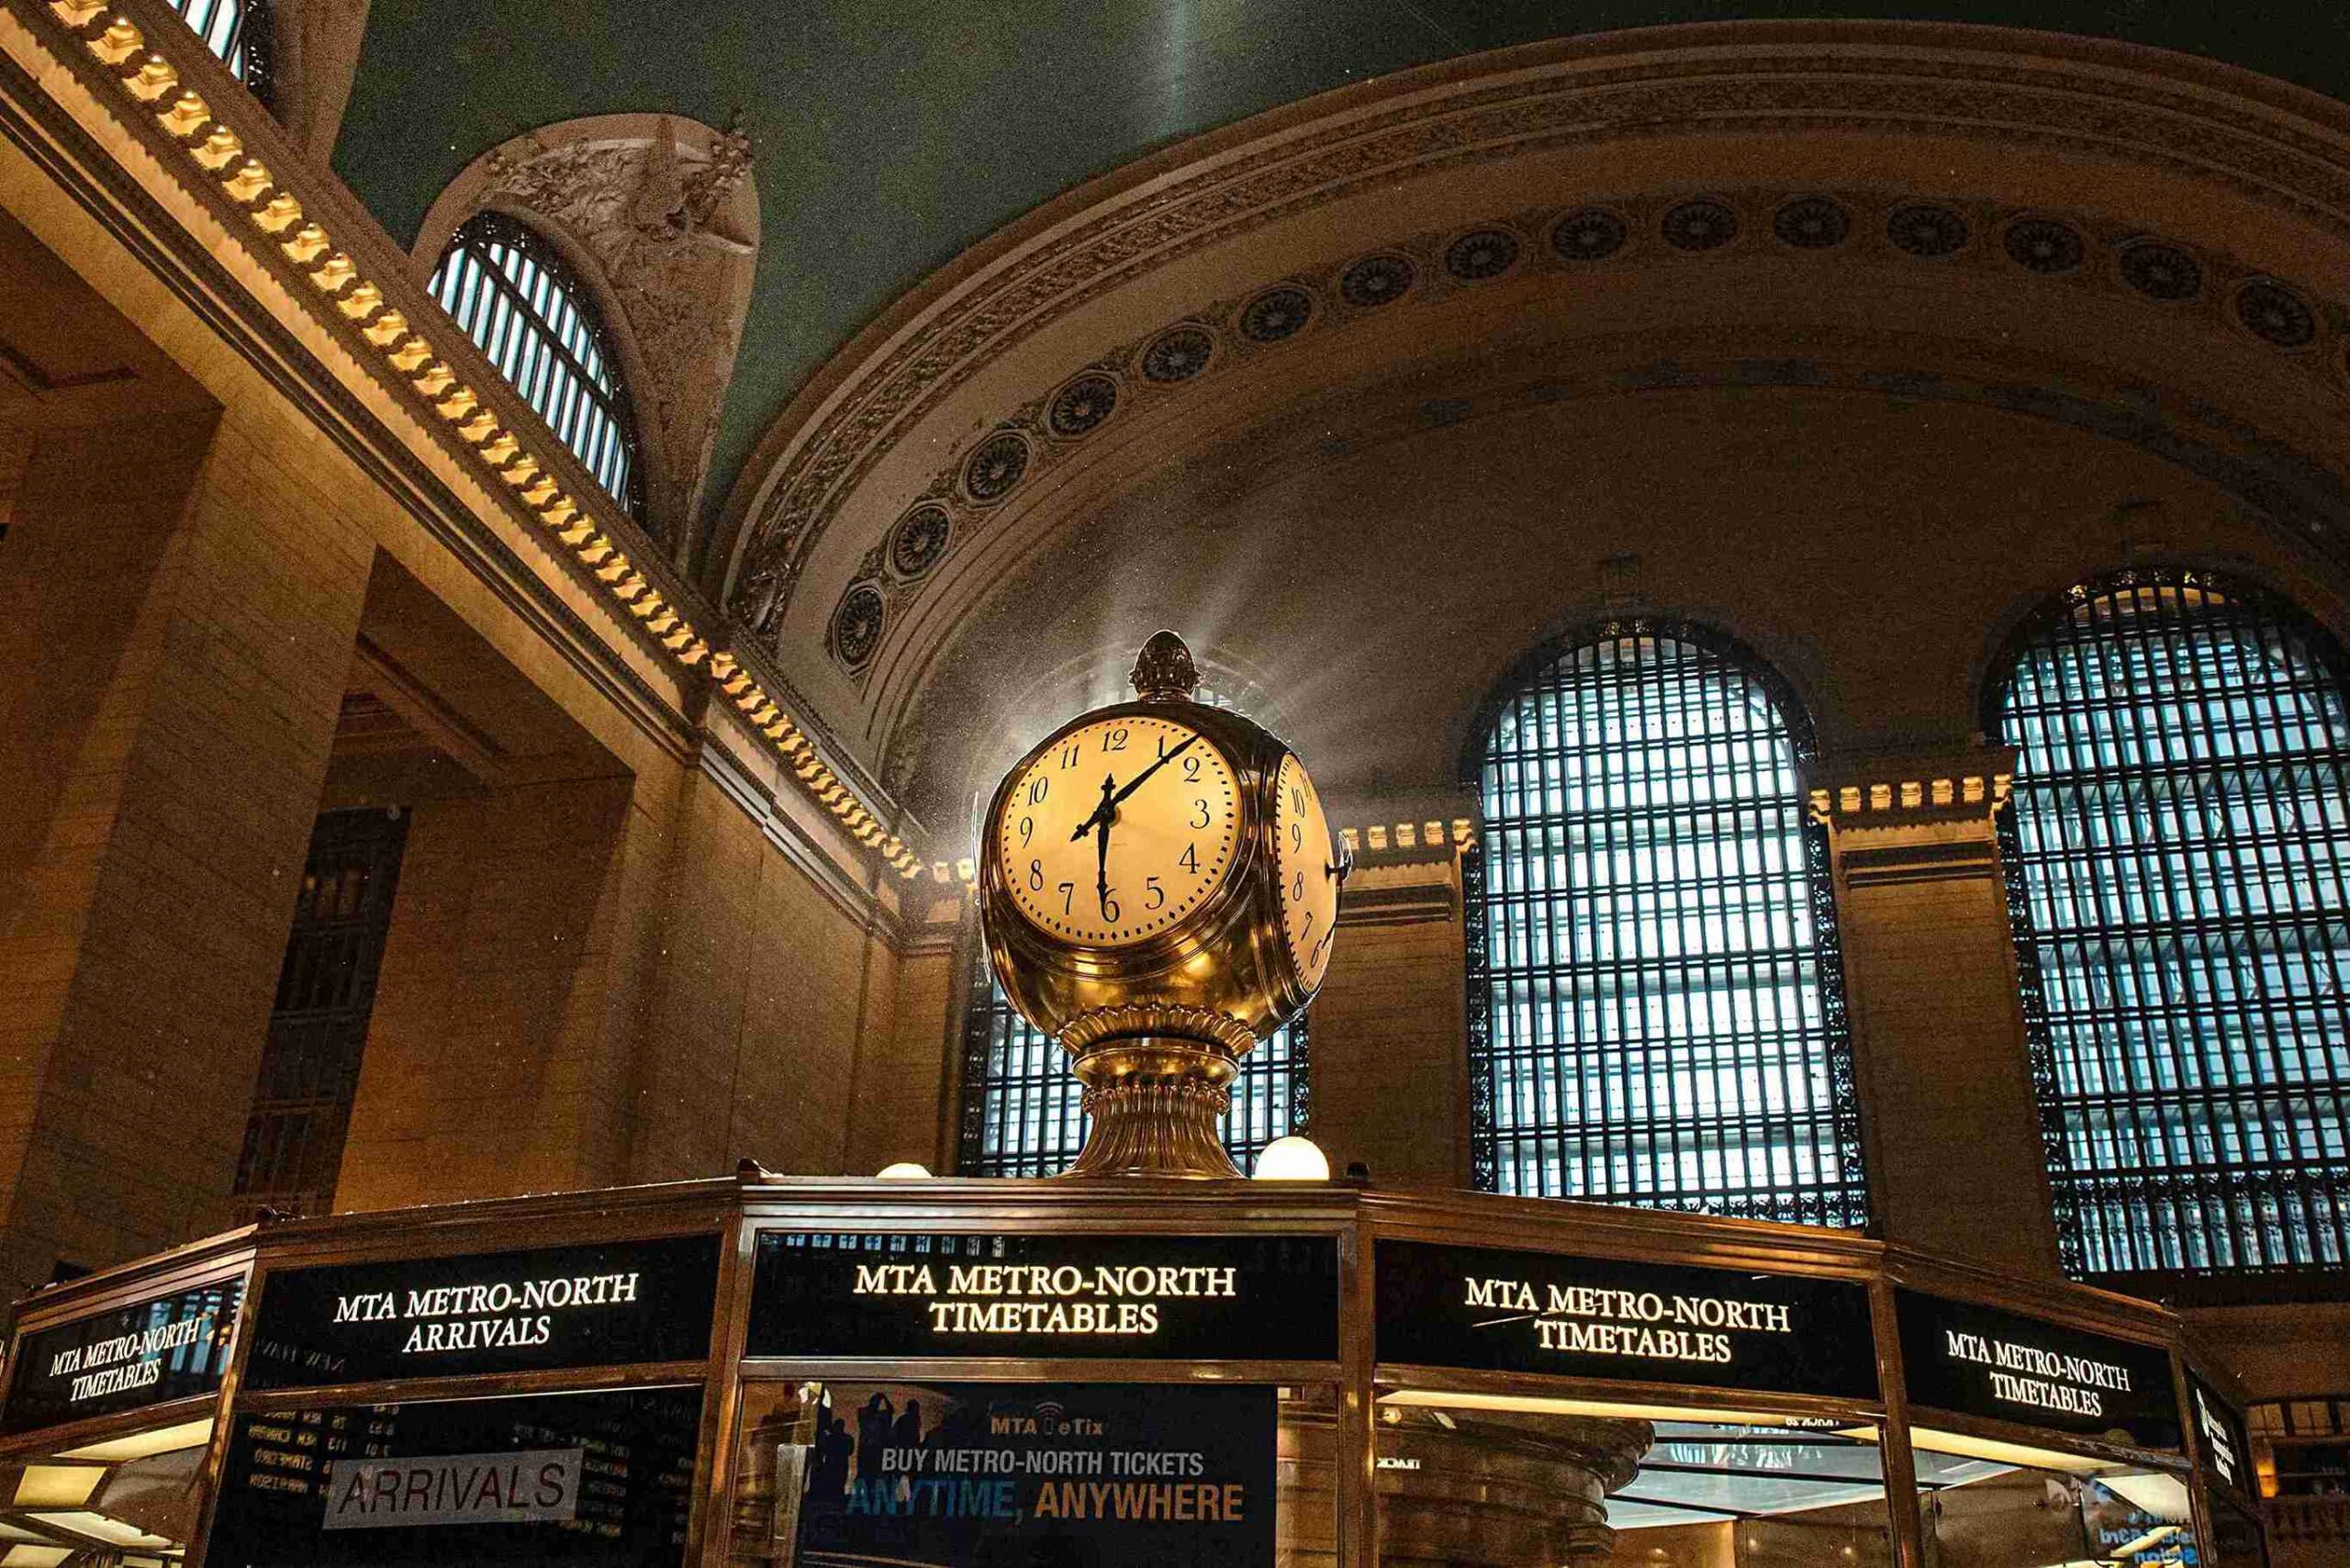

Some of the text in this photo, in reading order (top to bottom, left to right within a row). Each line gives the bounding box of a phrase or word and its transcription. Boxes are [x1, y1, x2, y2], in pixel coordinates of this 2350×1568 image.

[1102, 728, 1129, 753] 12
[1060, 746, 1079, 769] 11
[1183, 756, 1201, 783] 2
[1027, 777, 1048, 806] 10
[1291, 787, 1305, 818] 10
[1191, 799, 1210, 829] 3
[1020, 817, 1034, 848] 9
[1292, 823, 1302, 854] 9
[1179, 843, 1200, 874] 4
[1029, 859, 1043, 890] 8
[1292, 871, 1304, 902] 8
[1058, 882, 1075, 915] 7
[1102, 888, 1121, 923] 6
[1145, 877, 1165, 909] 5
[1301, 912, 1313, 941] 7
[1311, 939, 1322, 969] 6
[854, 1265, 1237, 1297] MTA METRO-NORTH
[333, 1273, 639, 1323] MTA METRO-NORTH
[1464, 1278, 1791, 1332] MTA METRO-NORTH
[928, 1302, 1158, 1334] TIMETABLES
[50, 1317, 201, 1376] MTA METRO-NORTH
[402, 1316, 550, 1353] ARRIVALS
[1534, 1318, 1731, 1363] TIMETABLES
[1946, 1330, 2131, 1392] MTA METRO-NORTH
[70, 1358, 162, 1401] TIMETABLES
[1989, 1372, 2102, 1417] TIMETABLES
[991, 1417, 1102, 1436] MTA eTix
[882, 1448, 1204, 1476] BUY METRO-NORTH TICKETS
[337, 1462, 565, 1516] ARRIVALS
[845, 1477, 1245, 1526] ANYTIME, ANYWHERE
